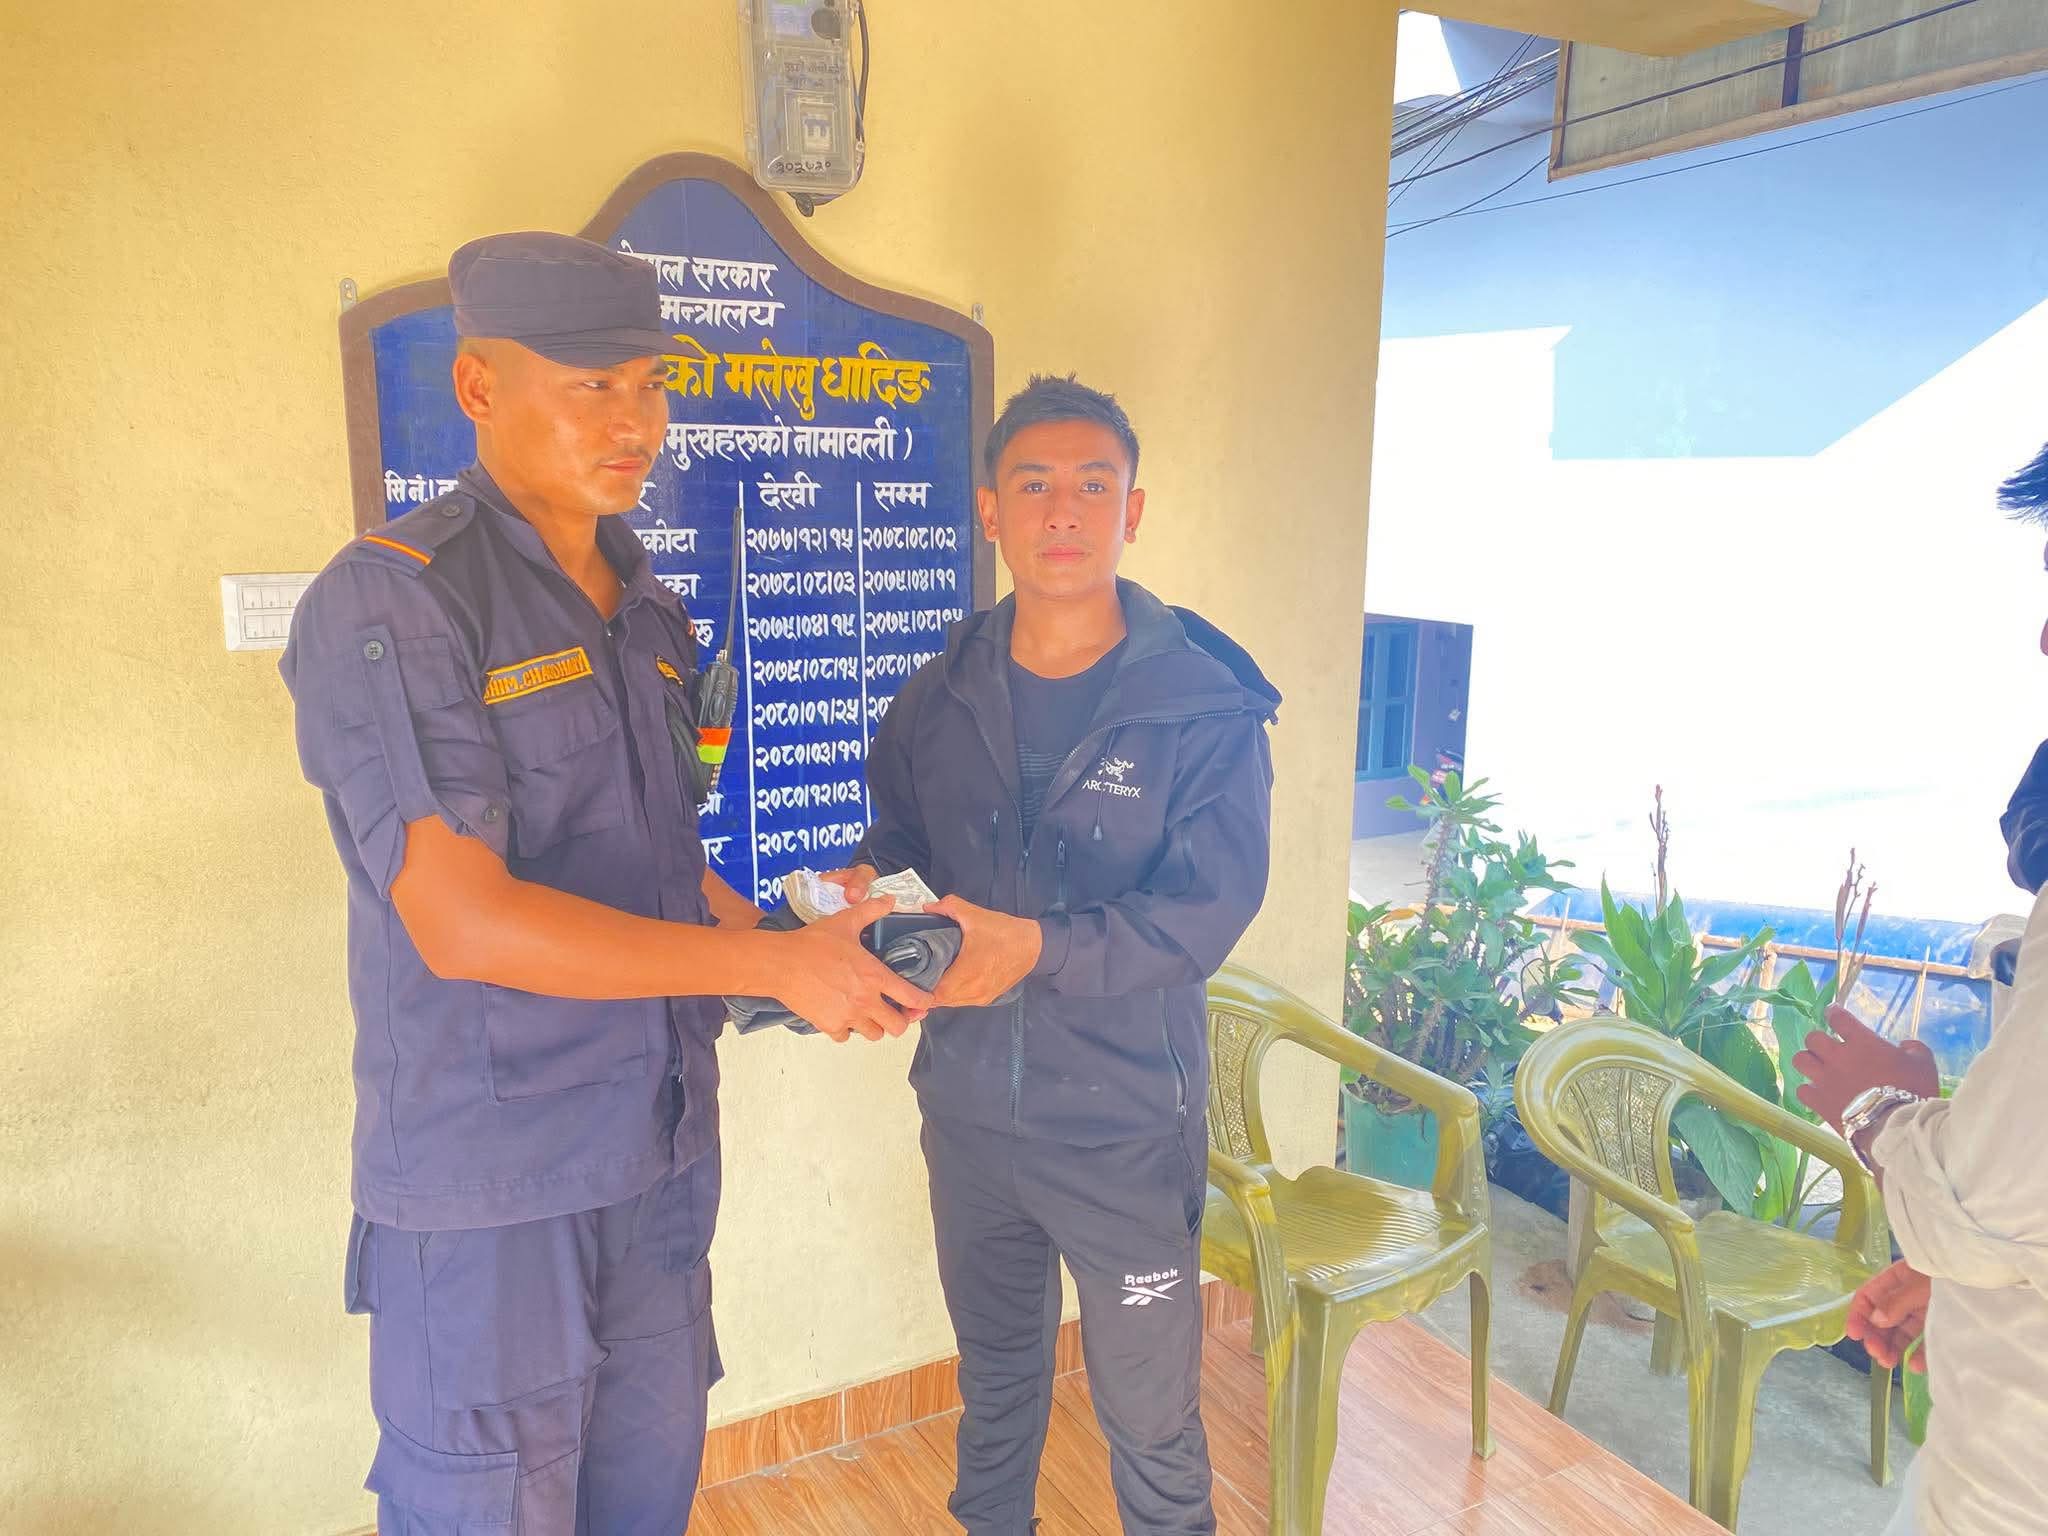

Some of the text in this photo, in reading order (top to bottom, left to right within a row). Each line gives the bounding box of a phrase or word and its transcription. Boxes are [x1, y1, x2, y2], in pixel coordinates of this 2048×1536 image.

[691, 256, 779, 297] सरकार
[723, 337, 820, 421] मलेखु
[756, 471, 823, 512] देखी
[873, 481, 934, 512] सम्म
